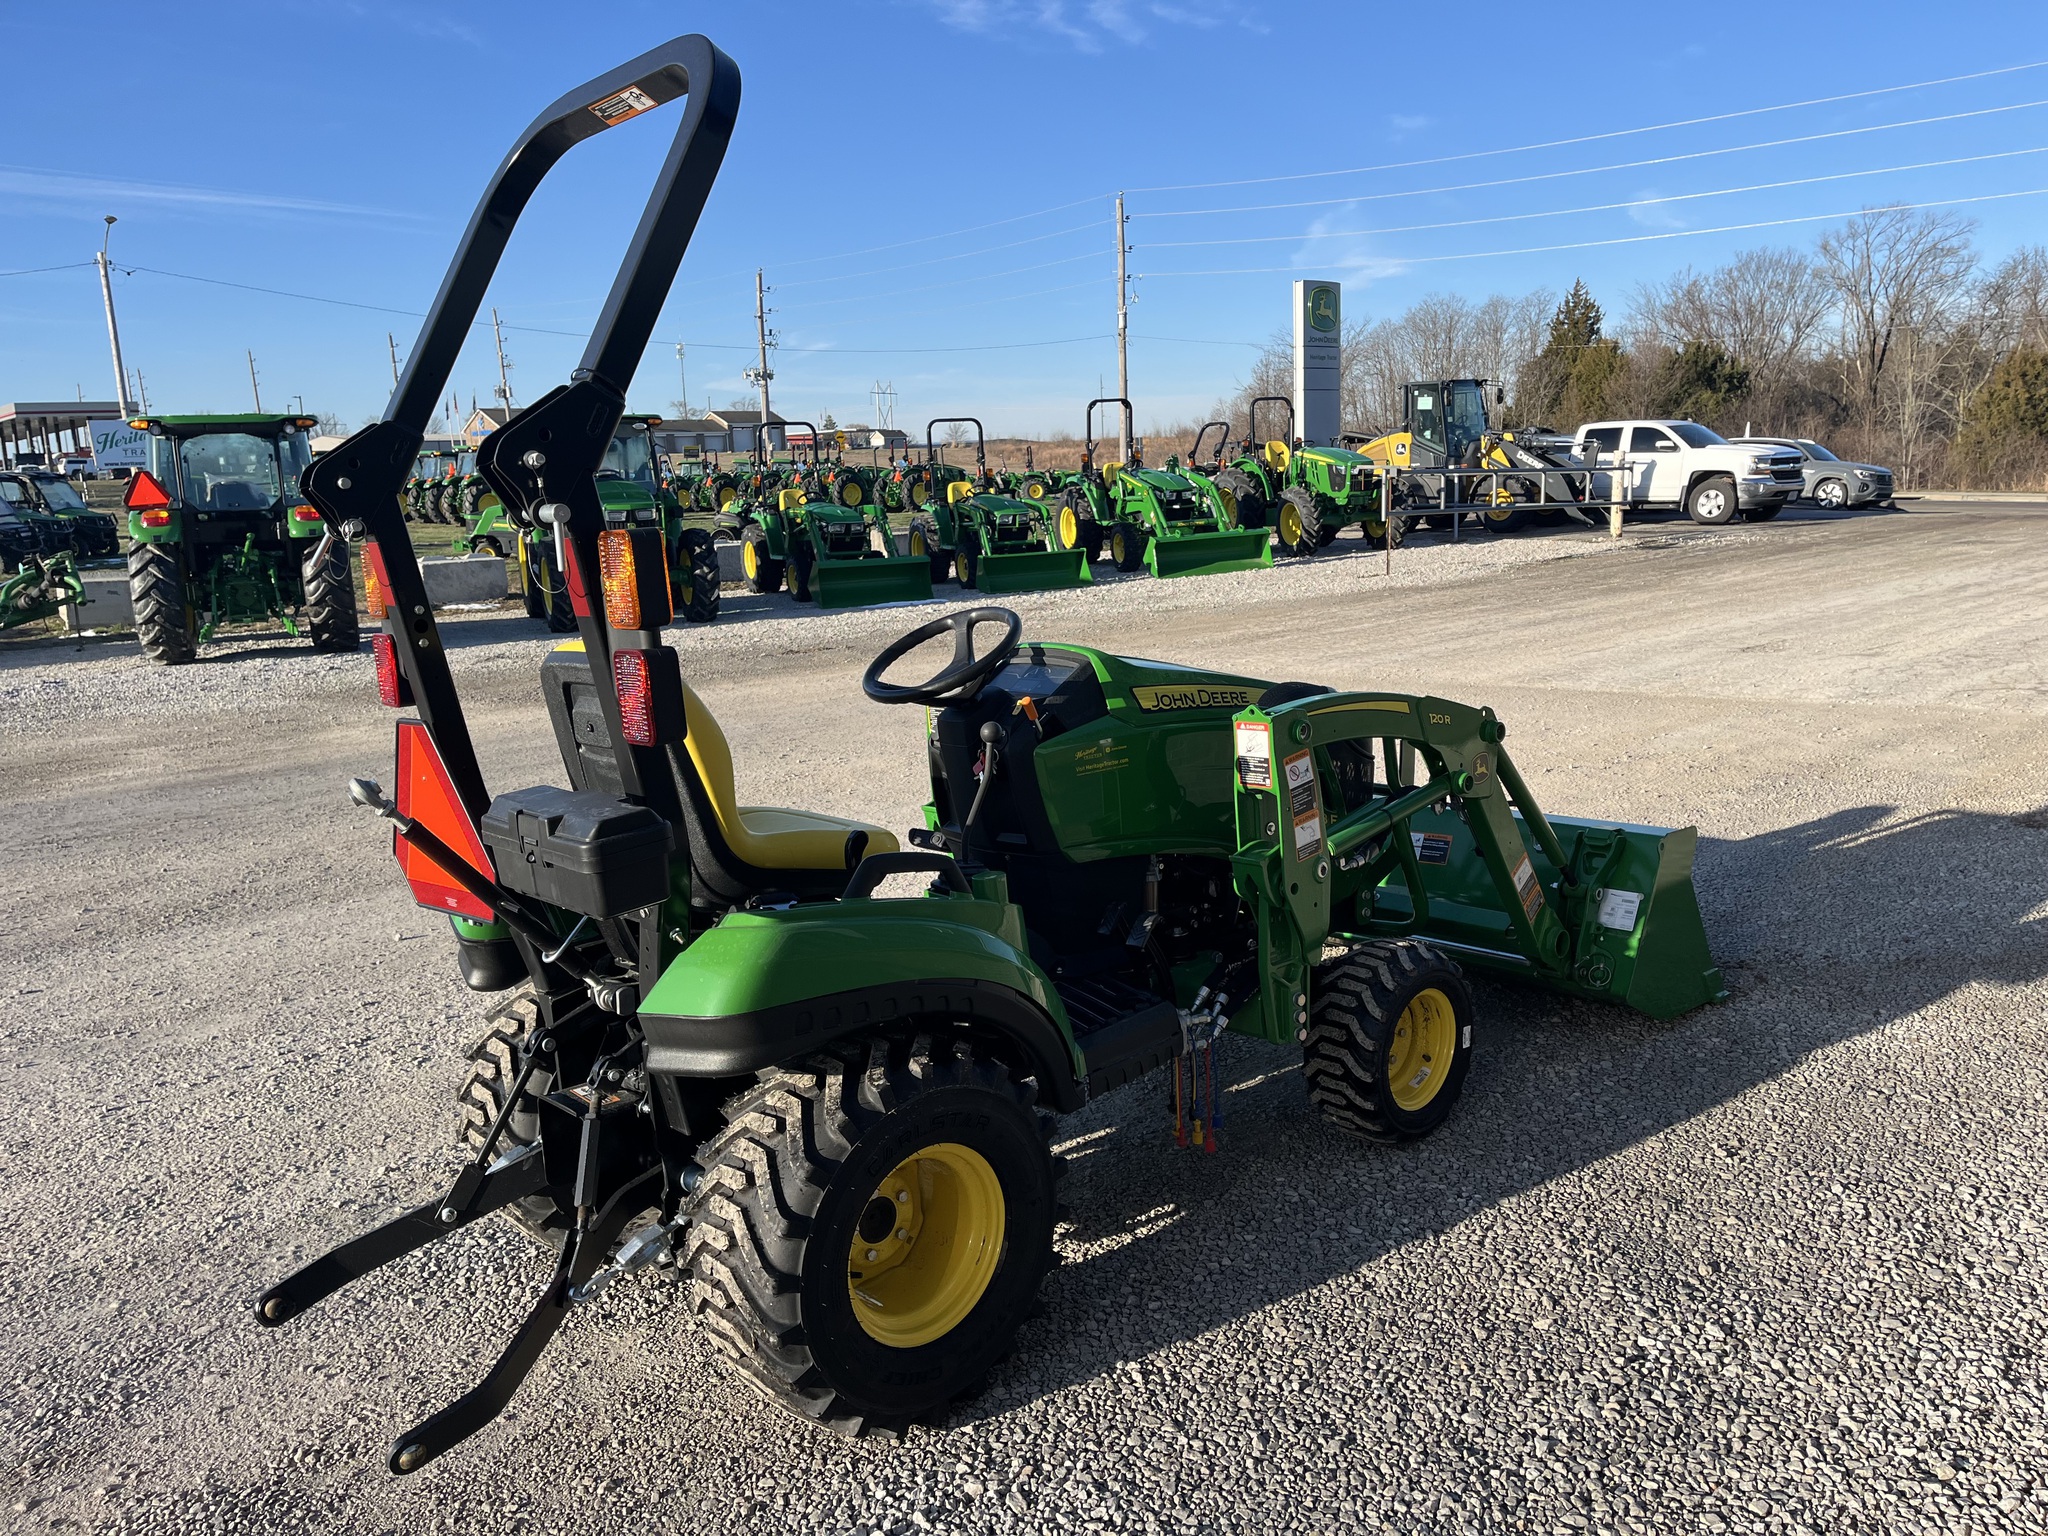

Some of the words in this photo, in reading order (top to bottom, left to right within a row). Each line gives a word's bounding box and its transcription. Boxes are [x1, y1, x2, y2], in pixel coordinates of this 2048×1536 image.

[1516, 450, 1544, 469] DEERE
[1151, 692, 1195, 709] JOHN
[1197, 689, 1250, 705] DEERE
[1429, 713, 1444, 725] 120
[1445, 715, 1451, 725] R
[1288, 750, 1309, 763] WARNING
[866, 1111, 992, 1178] CARLSTAR
